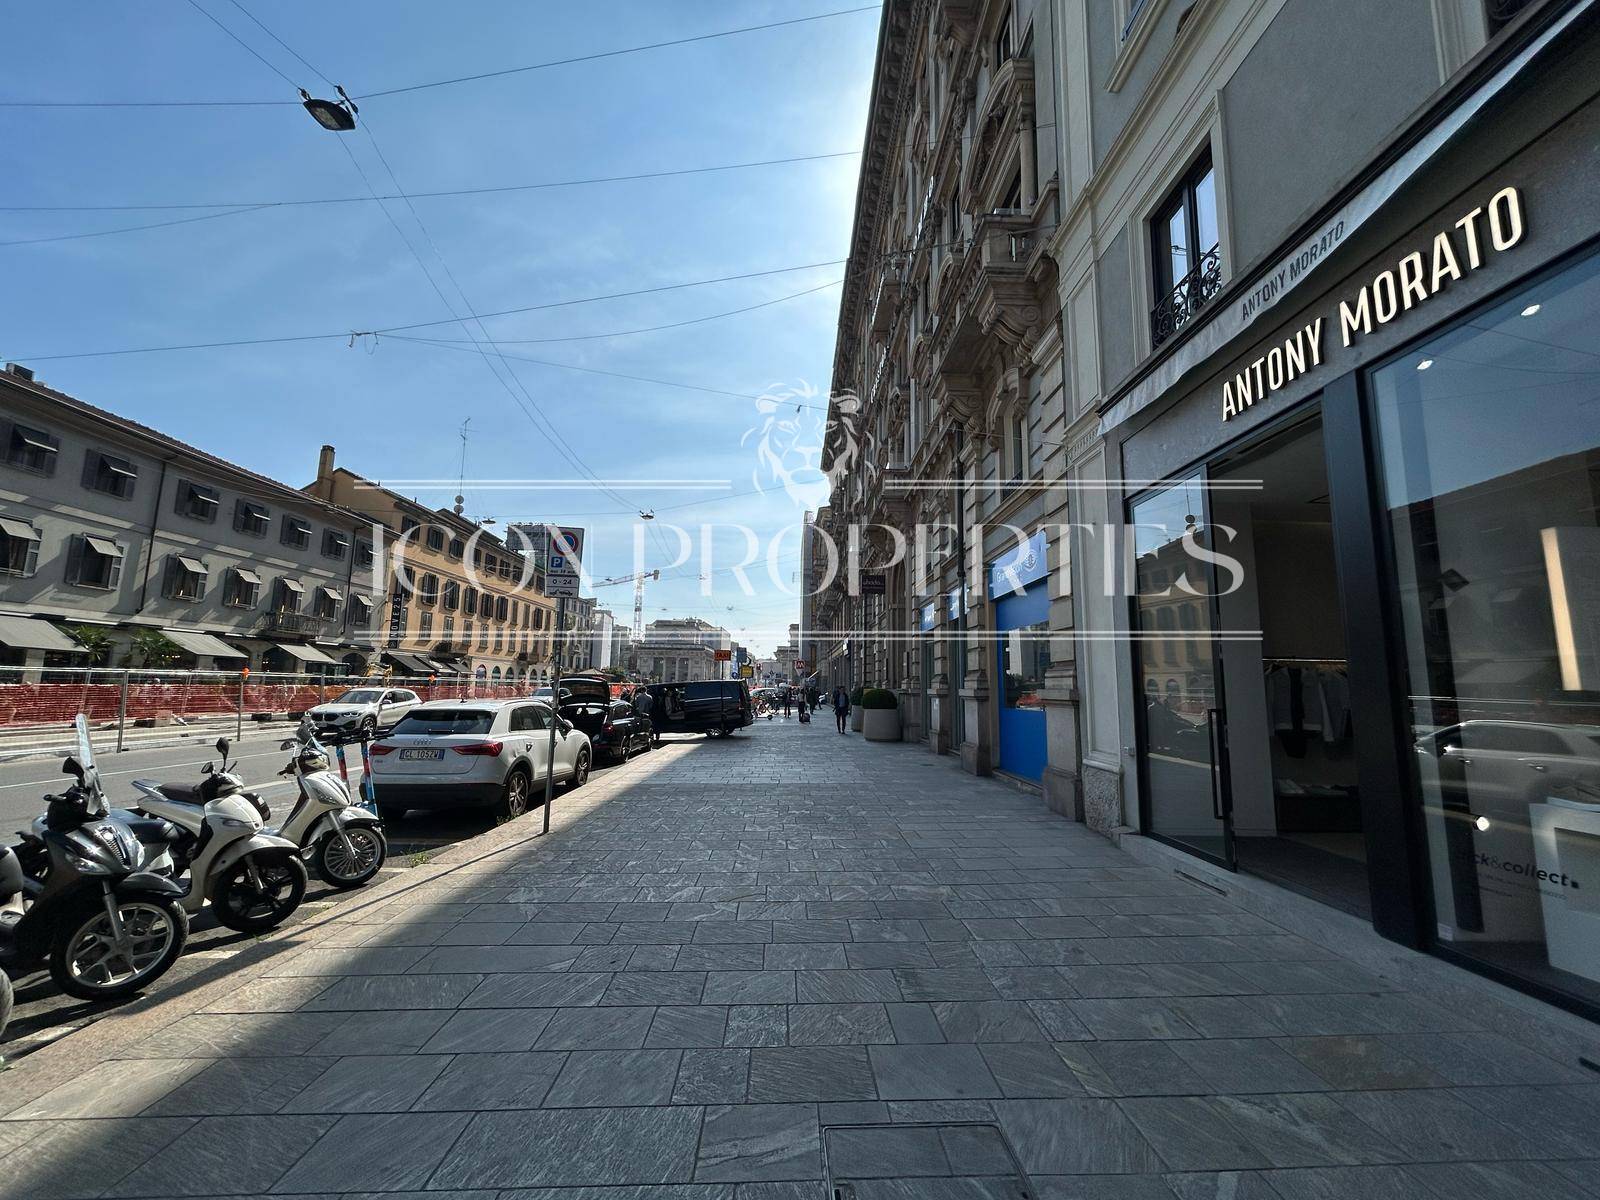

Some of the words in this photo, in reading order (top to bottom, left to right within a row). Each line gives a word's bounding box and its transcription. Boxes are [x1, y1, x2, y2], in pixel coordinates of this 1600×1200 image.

[1222, 317, 1322, 421] ANTONY
[1339, 186, 1524, 347] MORATO
[1241, 270, 1286, 321] ANTONY
[1289, 221, 1344, 281] MORATO
[390, 597, 401, 637] NOVE25
[1467, 851, 1571, 887] ck&collect
